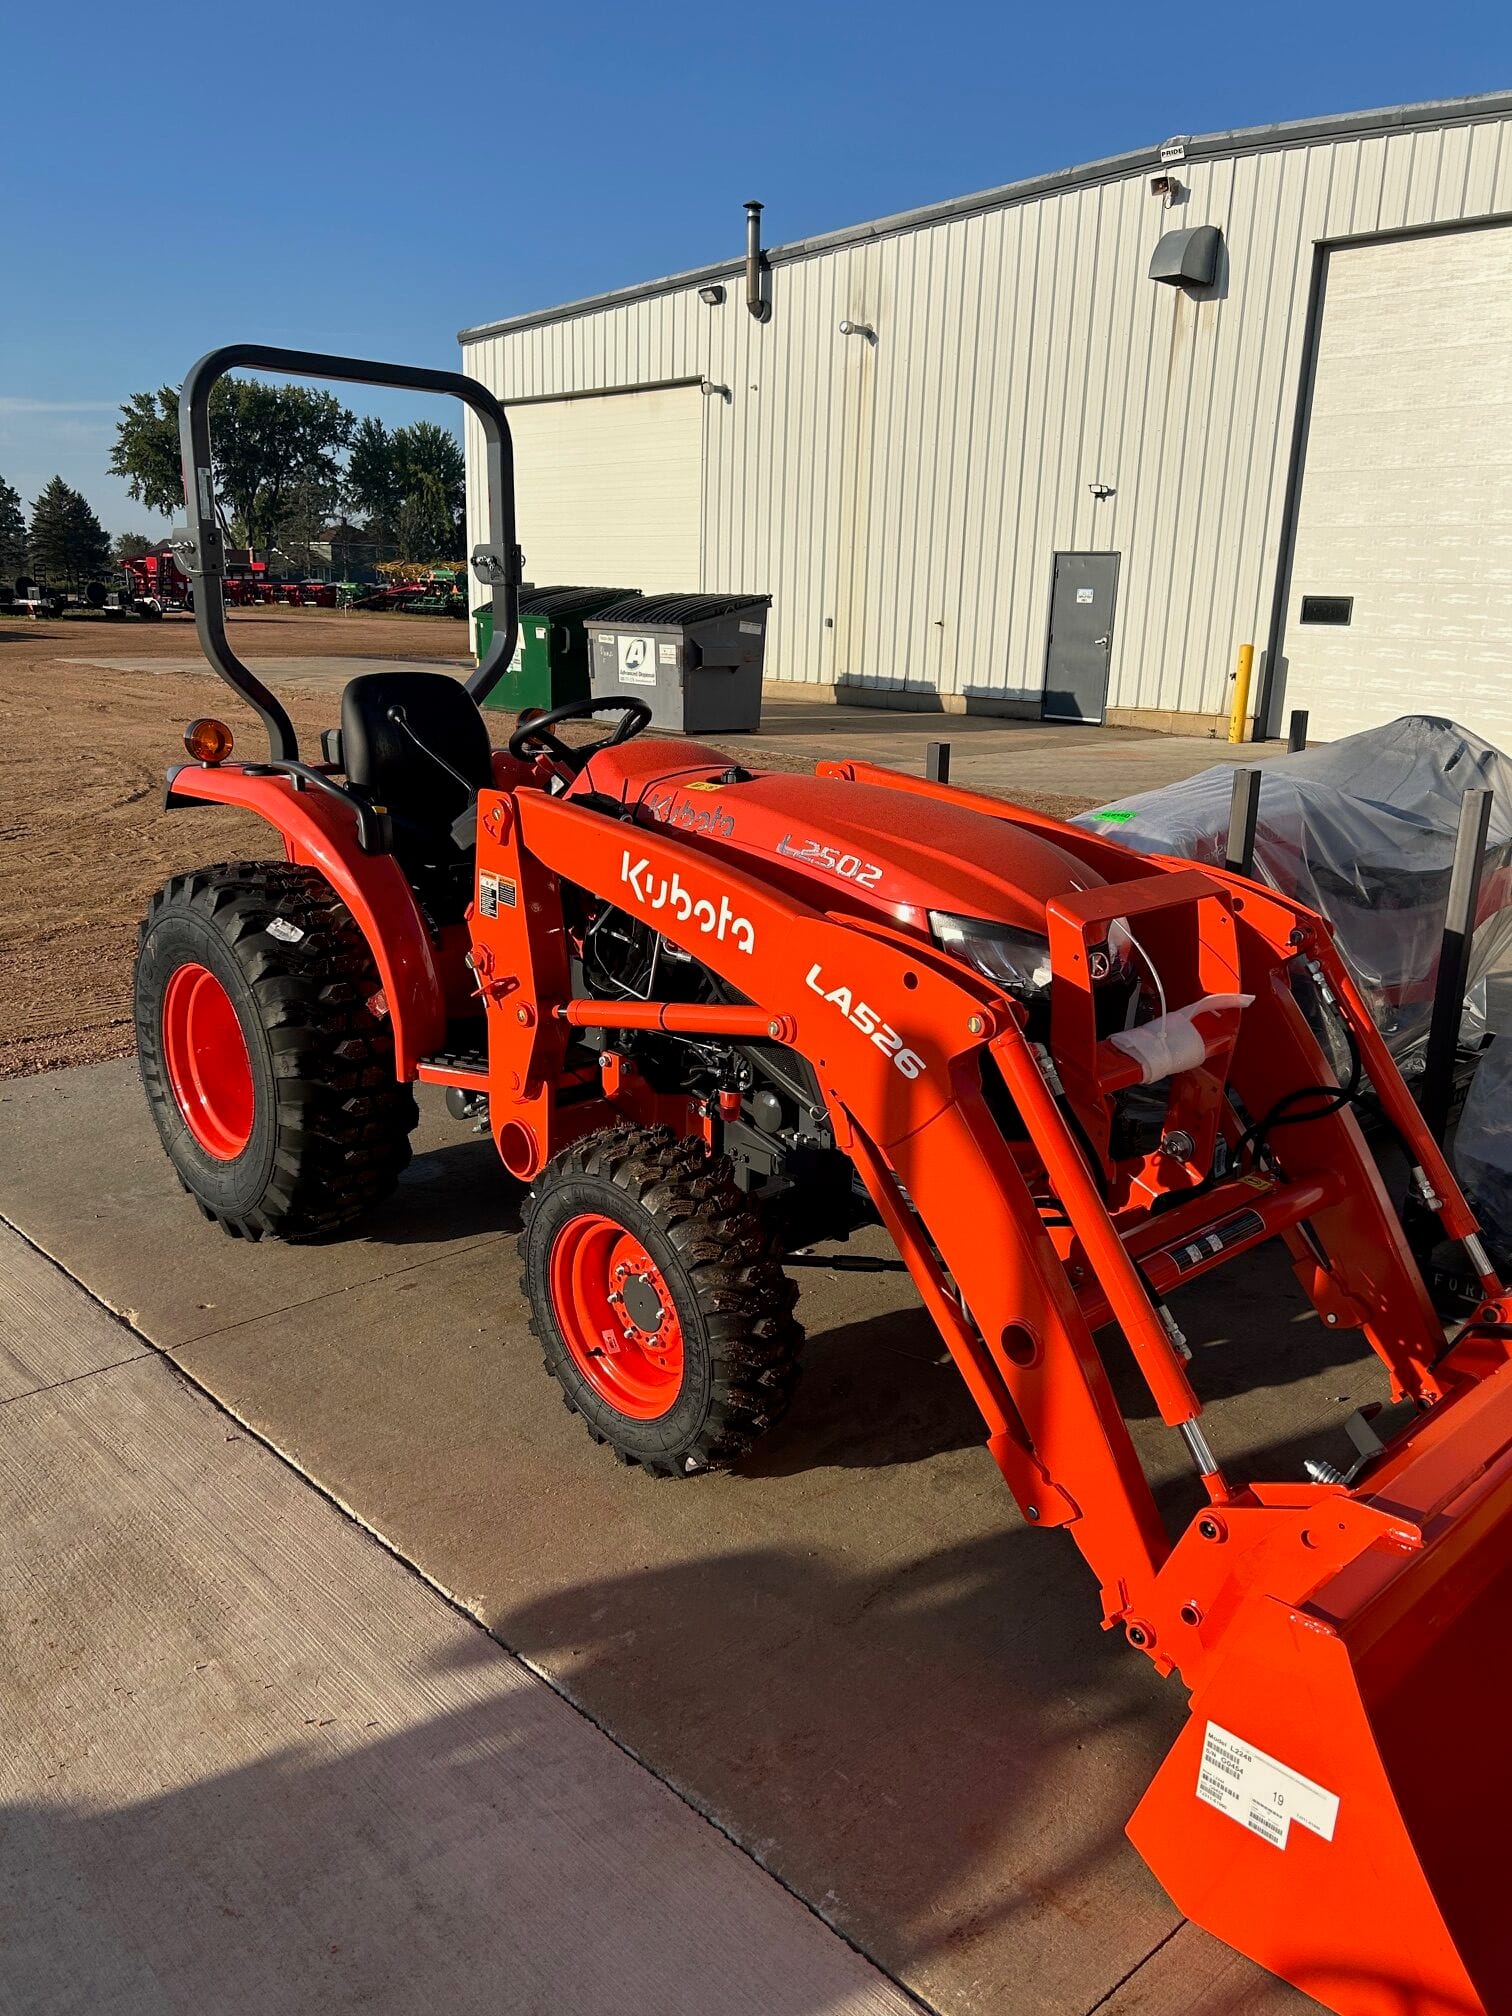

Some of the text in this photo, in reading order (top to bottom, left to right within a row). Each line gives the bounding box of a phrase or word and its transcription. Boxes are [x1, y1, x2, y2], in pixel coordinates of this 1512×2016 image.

[1161, 147, 1184, 157] PRIDE
[648, 792, 736, 837] Kubota
[775, 833, 884, 889] L2502
[620, 850, 755, 955] Kubota
[805, 963, 927, 1080] LA526
[1208, 1732, 1227, 1747] Model
[1273, 1791, 1285, 1807] 19
